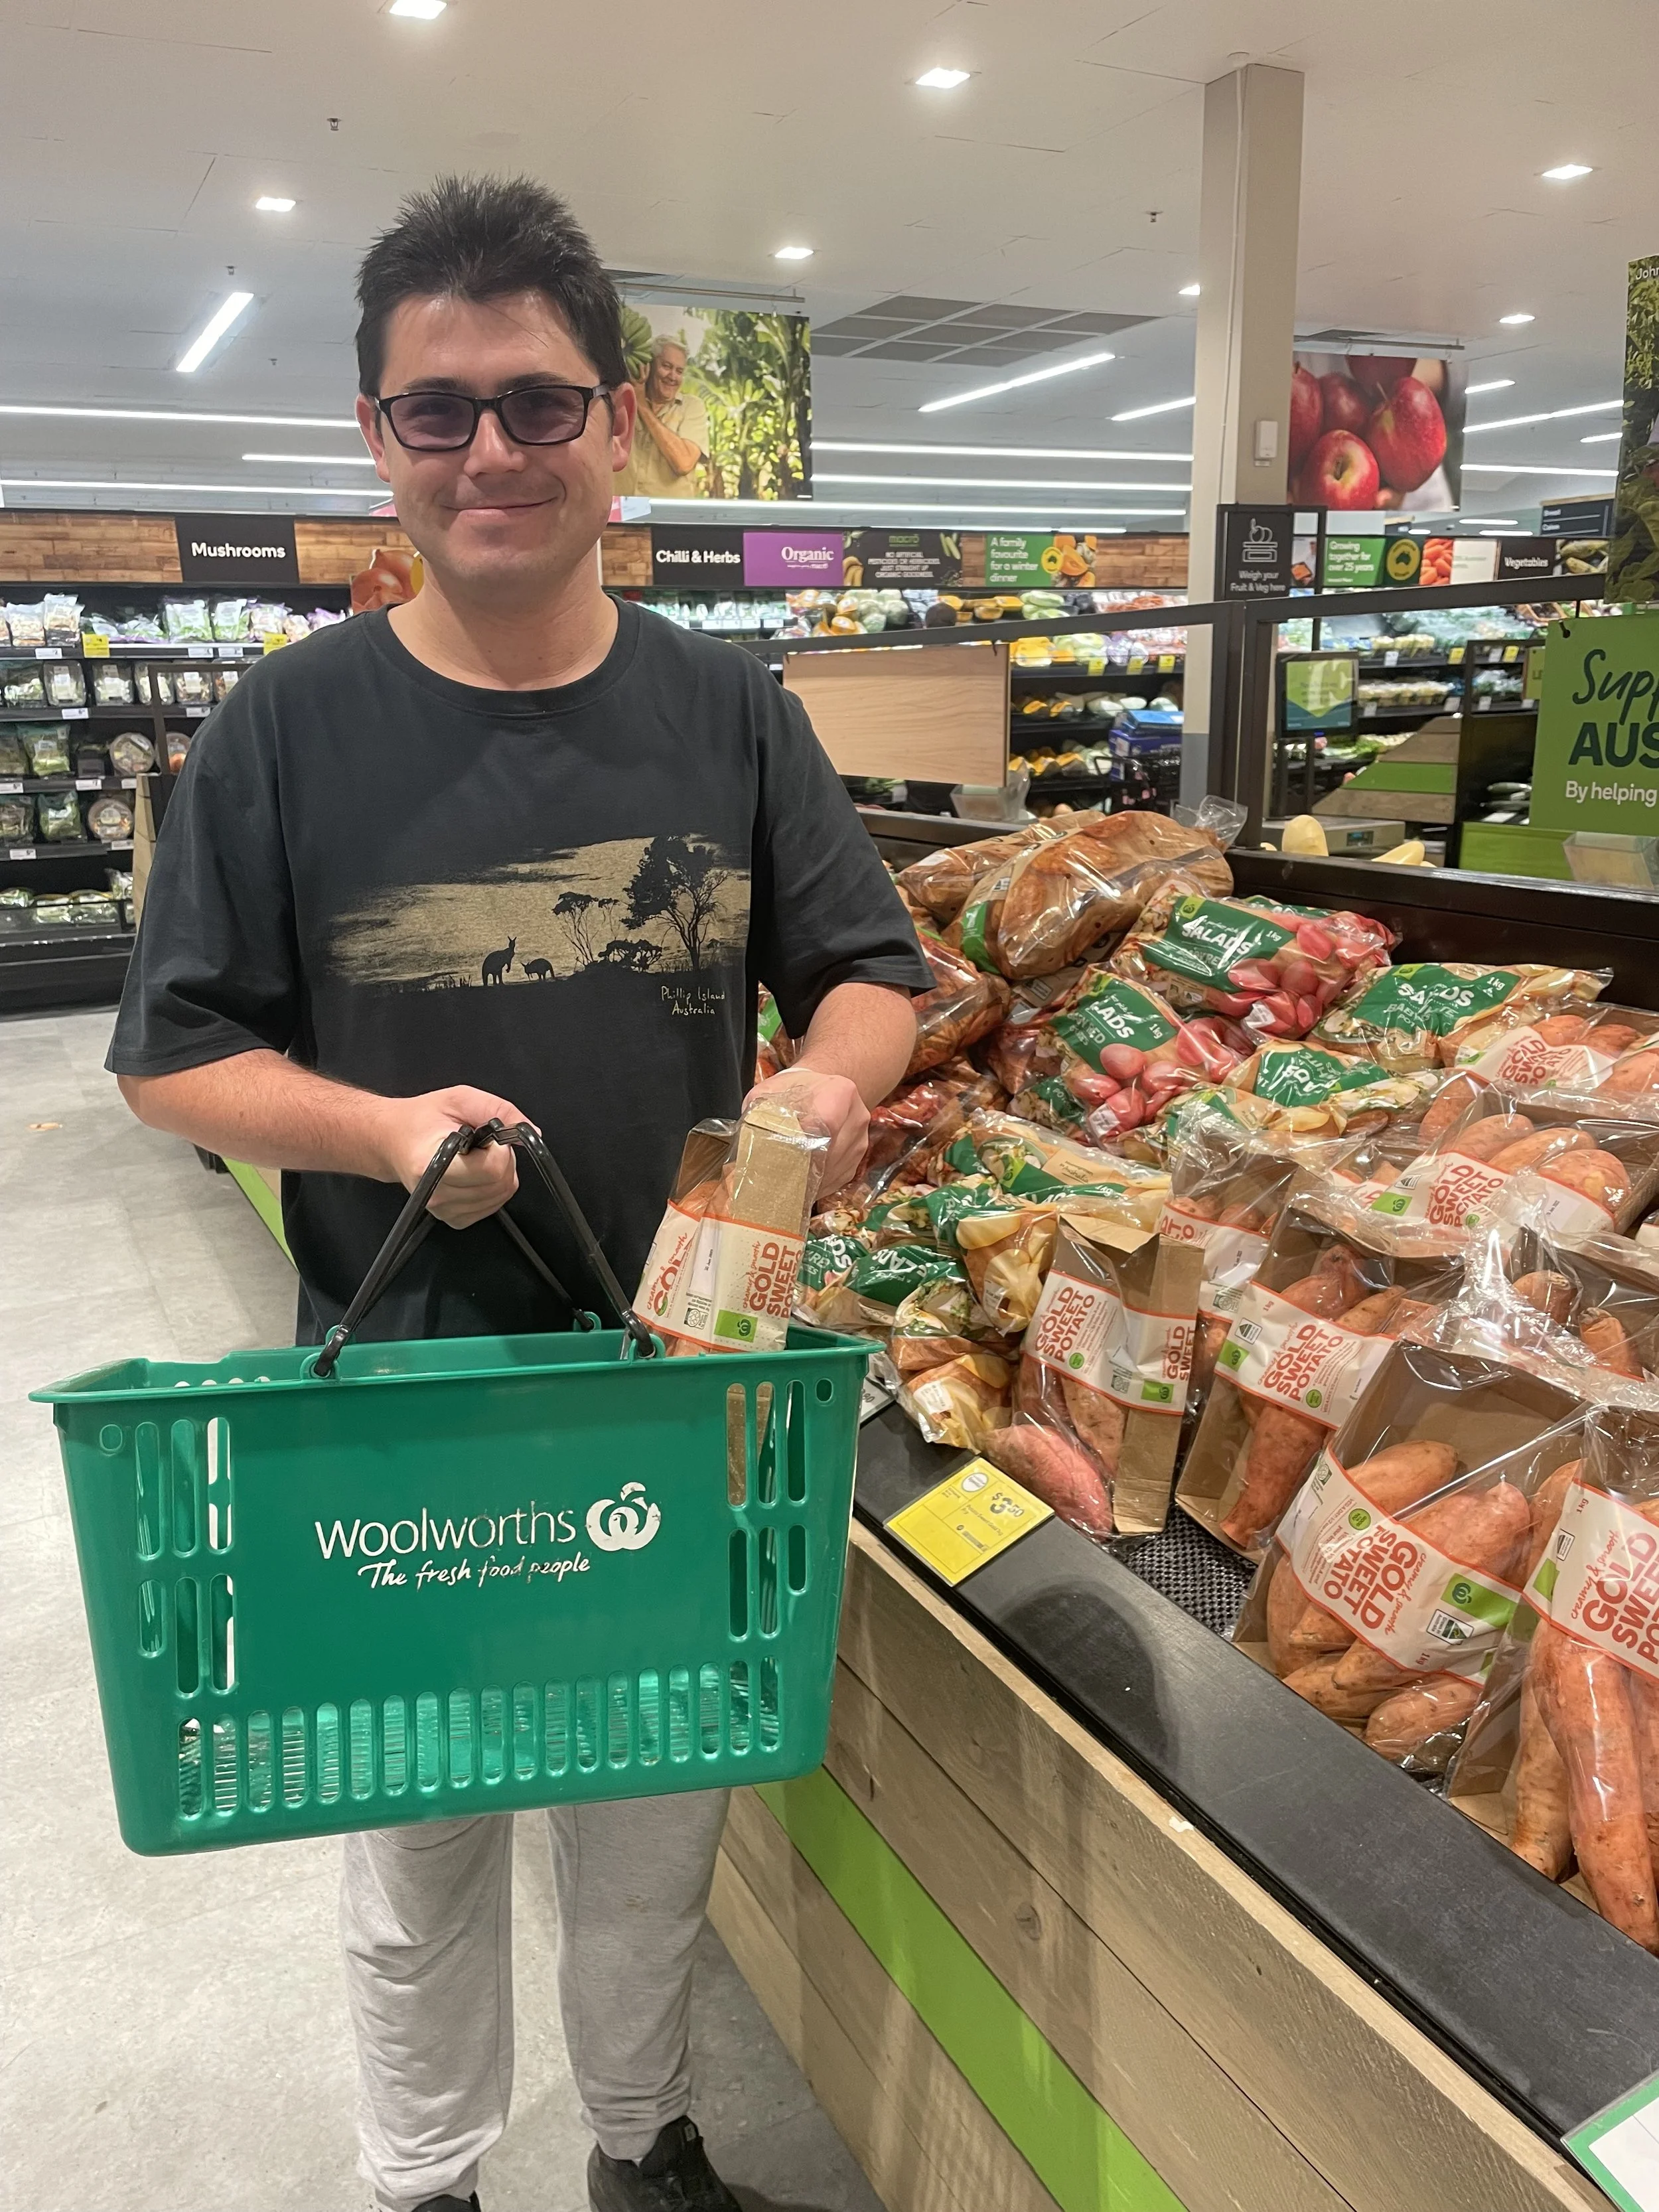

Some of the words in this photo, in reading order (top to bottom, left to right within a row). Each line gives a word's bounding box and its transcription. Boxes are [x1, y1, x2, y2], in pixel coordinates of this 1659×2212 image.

[191, 542, 286, 558] Mushrooms
[656, 550, 690, 563] Chilli
[691, 550, 702, 563] &
[703, 551, 741, 563] Herbs
[781, 547, 834, 562] Organic
[990, 550, 1029, 559] favourite
[991, 538, 998, 546] A
[999, 537, 1027, 550] family
[1329, 541, 1360, 552] Growing
[1329, 552, 1360, 563] together
[1360, 552, 1372, 561] for
[990, 561, 1002, 570] for
[1238, 570, 1262, 581] Weigh
[1263, 572, 1279, 581] your
[1344, 563, 1354, 571] 25
[1354, 564, 1374, 573] years
[1504, 557, 1549, 569] Vegetables
[989, 573, 1018, 582] dinner
[1230, 583, 1248, 591] Fruit
[1255, 583, 1269, 593] Veg
[1270, 583, 1285, 591] here
[1565, 780, 1588, 804] By
[1591, 781, 1658, 808] helping
[661, 985, 691, 1005] Phillip
[698, 986, 725, 1001] Island
[1486, 977, 1505, 991] 1kg
[672, 1000, 715, 1015] Australia
[1149, 1023, 1163, 1039] 1kg
[1429, 1165, 1475, 1224] GOLD
[1443, 1171, 1488, 1226] SWEET
[749, 1242, 780, 1311] GOLD
[767, 1245, 797, 1317] SWEET
[1035, 1286, 1074, 1351] GOLD
[1043, 1290, 1084, 1357] SWEET
[1054, 1294, 1095, 1363] POTATO
[1166, 1325, 1186, 1380] GOLD
[1263, 1324, 1317, 1388] GOLD
[1276, 1329, 1330, 1395] SWEET
[1288, 1335, 1344, 1402] POTATO
[1576, 1498, 1589, 1514] 1kg
[314, 1500, 577, 1560] Woolworths
[358, 1558, 408, 1589] The
[415, 1558, 472, 1592] fresh
[477, 1554, 526, 1588] food
[528, 1550, 591, 1585] people
[1342, 1530, 1398, 1616] SWEET
[1360, 1540, 1418, 1629] GOLD
[1404, 1552, 1427, 1591] creamy
[1582, 1532, 1657, 1632] GOLD
[1571, 1576, 1599, 1620] creamy
[1585, 1564, 1605, 1577] &
[1384, 1597, 1404, 1636] smooth
[1415, 1652, 1431, 1666] 1kg
